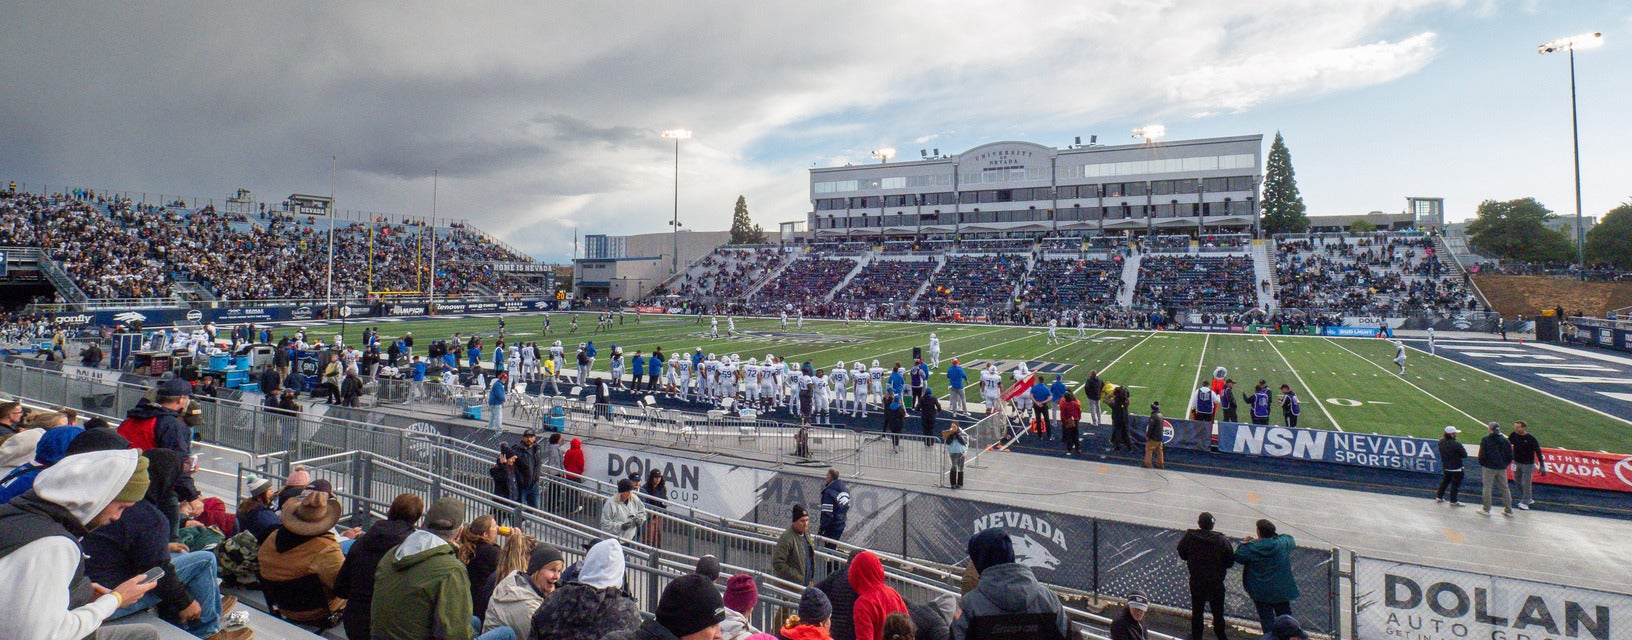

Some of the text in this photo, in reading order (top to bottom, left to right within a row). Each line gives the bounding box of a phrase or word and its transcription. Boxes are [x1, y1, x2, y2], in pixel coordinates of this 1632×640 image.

[975, 150, 1032, 161] UNIVERSITY
[557, 292, 565, 300] 20
[747, 370, 757, 378] 72
[1233, 425, 1436, 460] NSN NEVADA
[1335, 450, 1438, 472] SPORTSNET
[973, 511, 1068, 552] NEVADA
[1385, 573, 1610, 640] DOLAN
[1386, 612, 1468, 637] AUTO
[1386, 627, 1411, 639] GET
